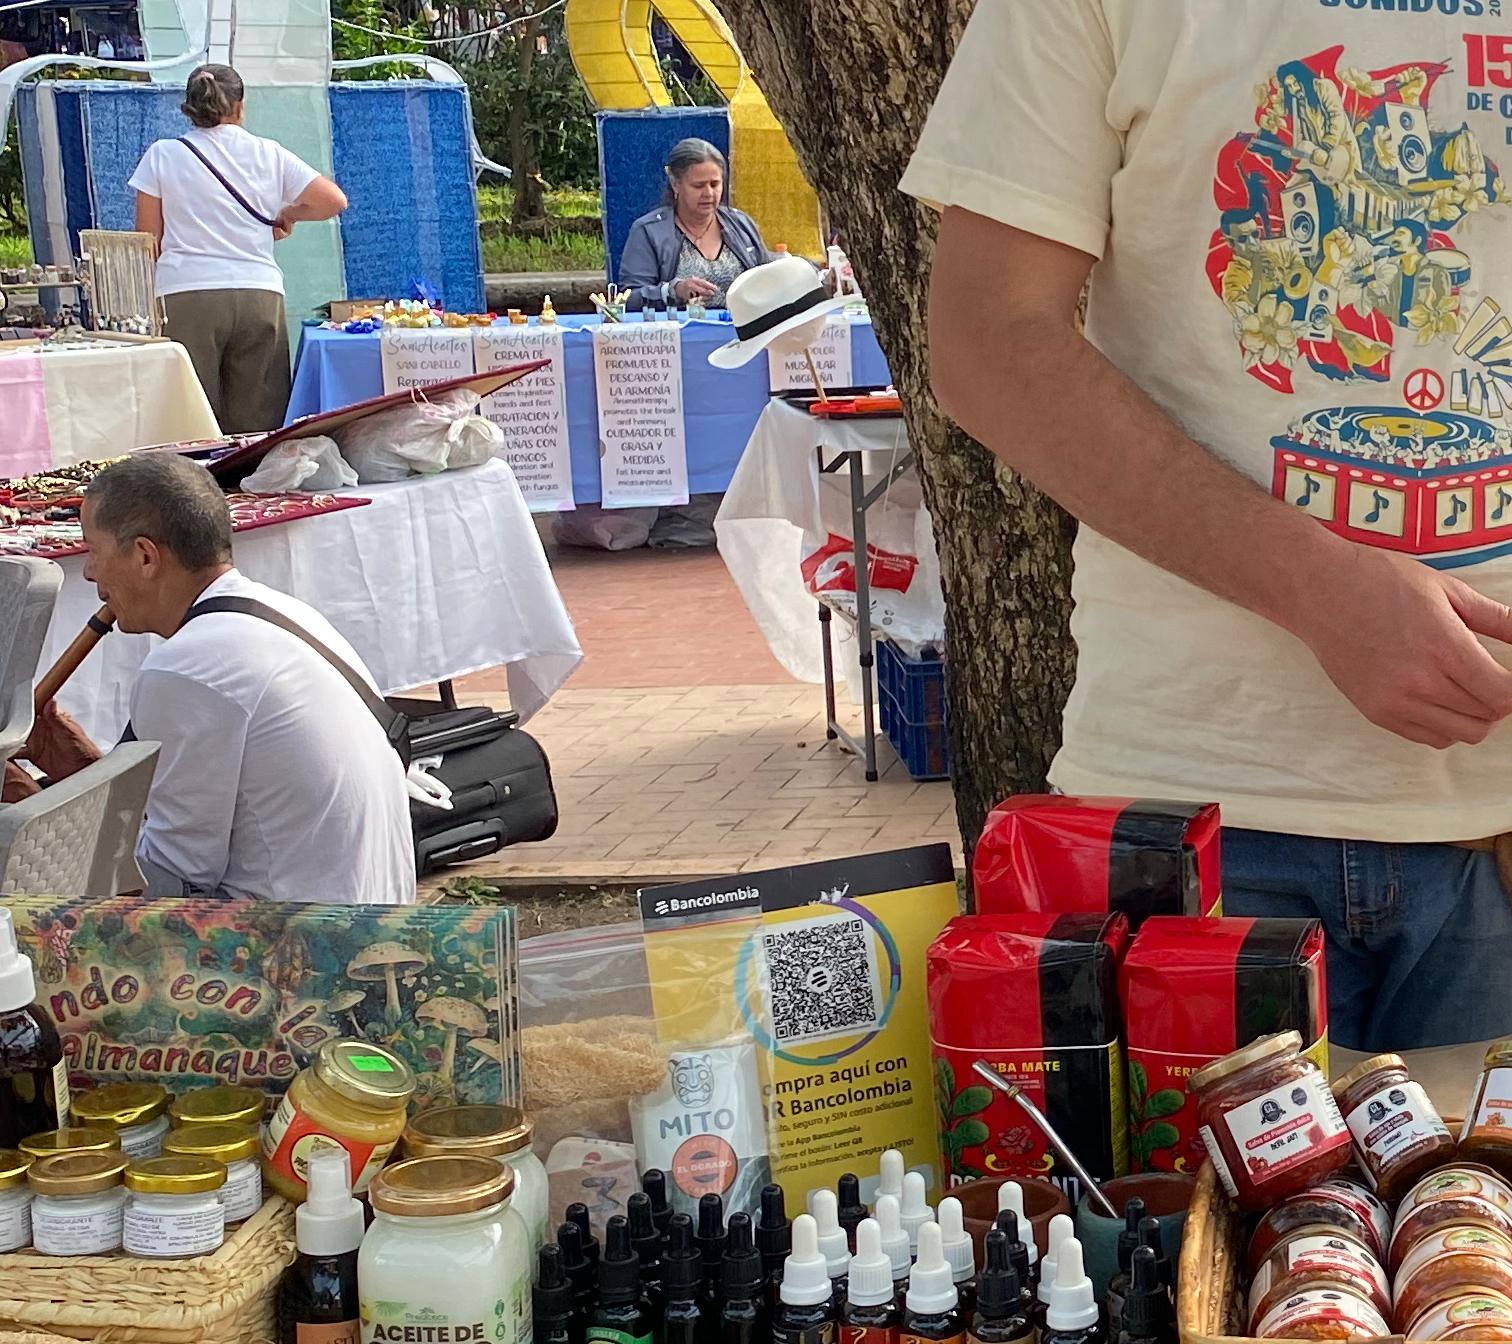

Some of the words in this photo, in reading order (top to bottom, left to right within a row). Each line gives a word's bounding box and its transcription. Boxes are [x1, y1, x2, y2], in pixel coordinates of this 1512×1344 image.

[1466, 92, 1493, 112] DE
[494, 351, 530, 361] CREMA
[532, 350, 543, 359] DE
[600, 345, 676, 355] AROMATERAPIA
[421, 360, 461, 370] CABELLO
[605, 358, 658, 369] PROMUEVE
[661, 358, 672, 368] EL
[535, 377, 556, 386] PIES
[609, 372, 660, 383] DESCANSO
[609, 387, 622, 396] LA
[625, 384, 671, 396] ARMONÍA
[606, 428, 662, 438] QUEMADOR
[664, 428, 676, 437] DE
[507, 437, 533, 449] UÑAS
[536, 438, 557, 448] CON
[621, 441, 654, 451] GRASA
[623, 455, 666, 464] MEDIDAS
[670, 885, 760, 911] Bancolombia
[169, 972, 263, 1016] con
[830, 1063, 870, 1084] aquí
[875, 1056, 908, 1073] con
[1022, 1060, 1061, 1072] MATE
[791, 1077, 912, 1116] Bancolombia
[660, 1108, 735, 1139] MITO
[373, 1324, 450, 1343] ACEITE
[456, 1323, 485, 1341] DE
